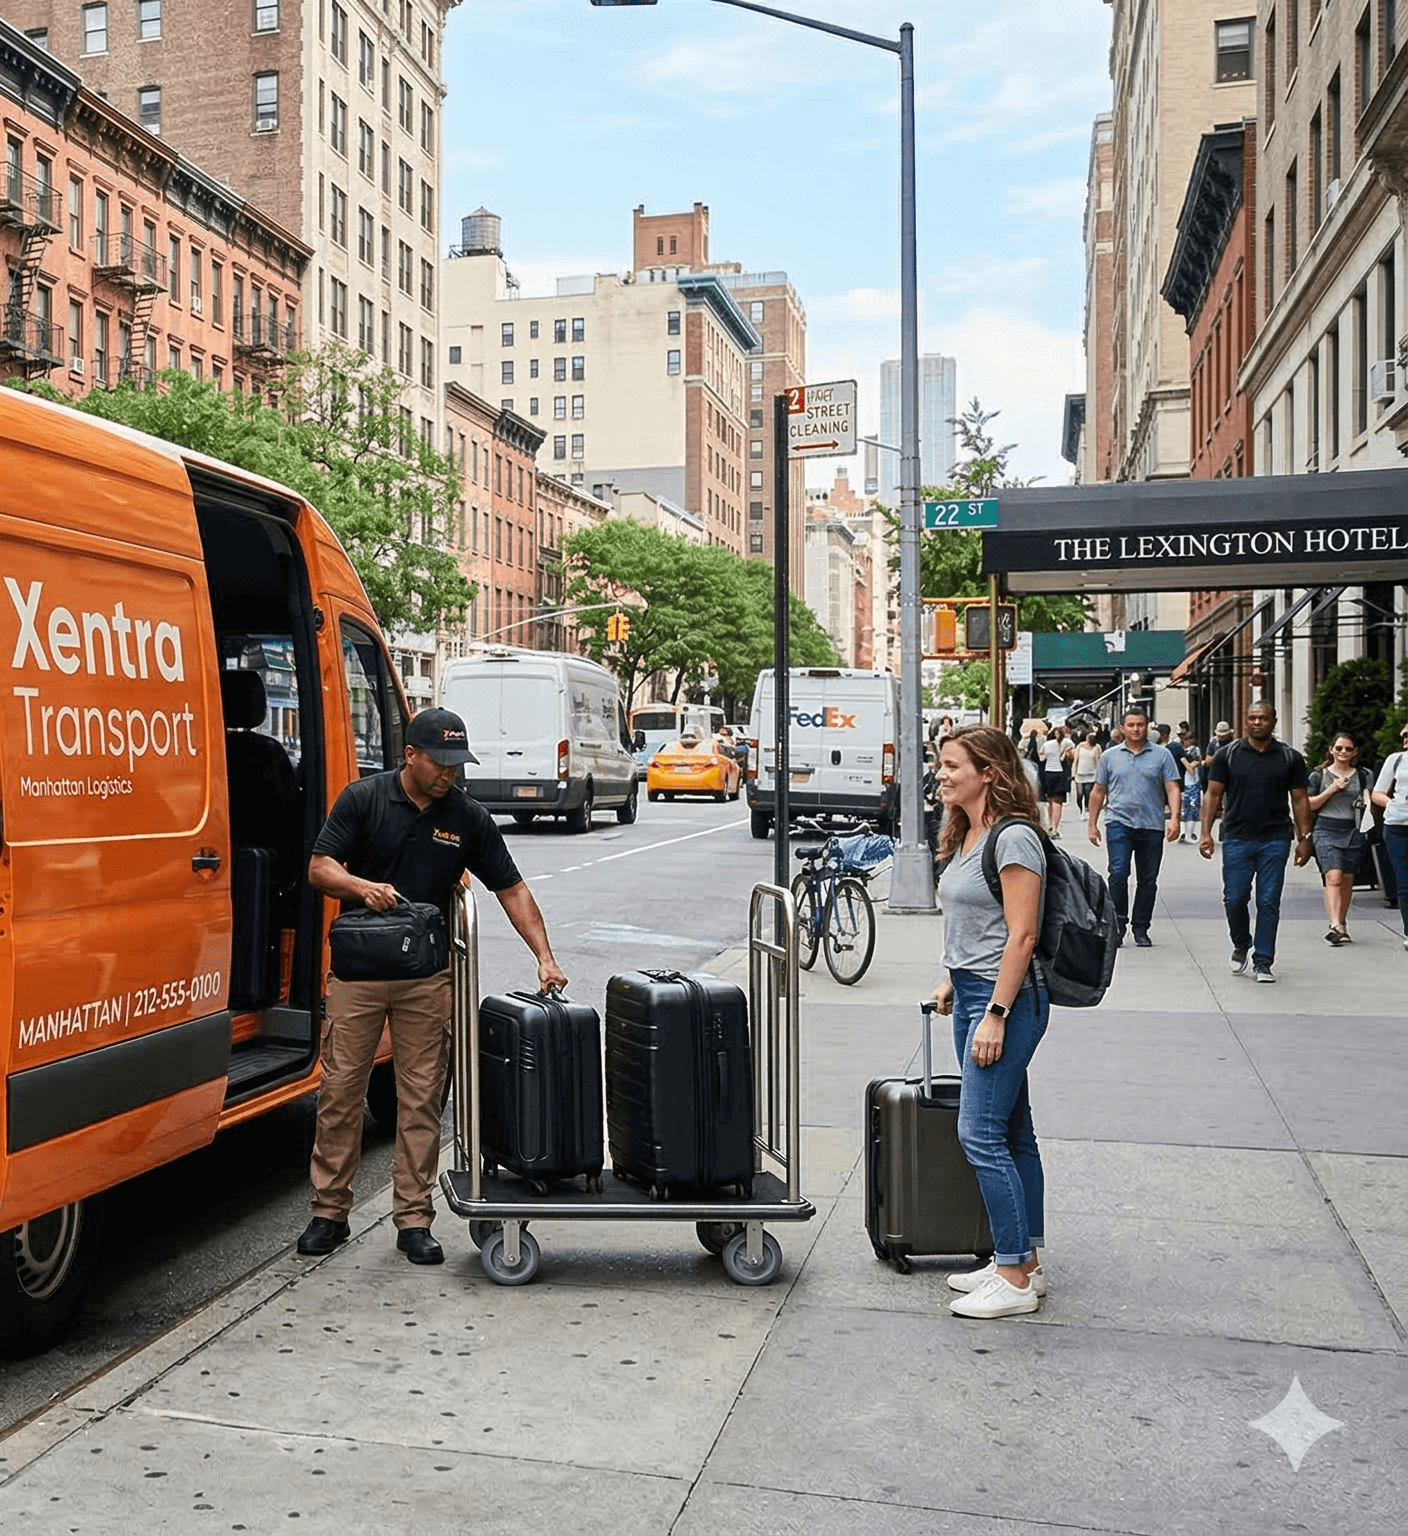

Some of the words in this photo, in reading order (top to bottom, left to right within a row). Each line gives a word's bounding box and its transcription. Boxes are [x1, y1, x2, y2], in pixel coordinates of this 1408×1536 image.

[806, 402, 851, 420] STREET
[789, 419, 849, 438] CLEANING
[934, 503, 960, 526] 22
[967, 502, 985, 516] ST
[1053, 537, 1112, 561] THE
[1118, 530, 1296, 560] LEXINGTON
[1303, 526, 1408, 553] HOTEL
[3, 576, 185, 683] Xentra
[12, 685, 197, 773] Transport
[789, 705, 857, 728] FedEx
[20, 776, 85, 798] Manhattan
[87, 775, 133, 800] Logistics
[18, 996, 123, 1050] MANHATTAN
[133, 971, 221, 1019] 212-555-0100
